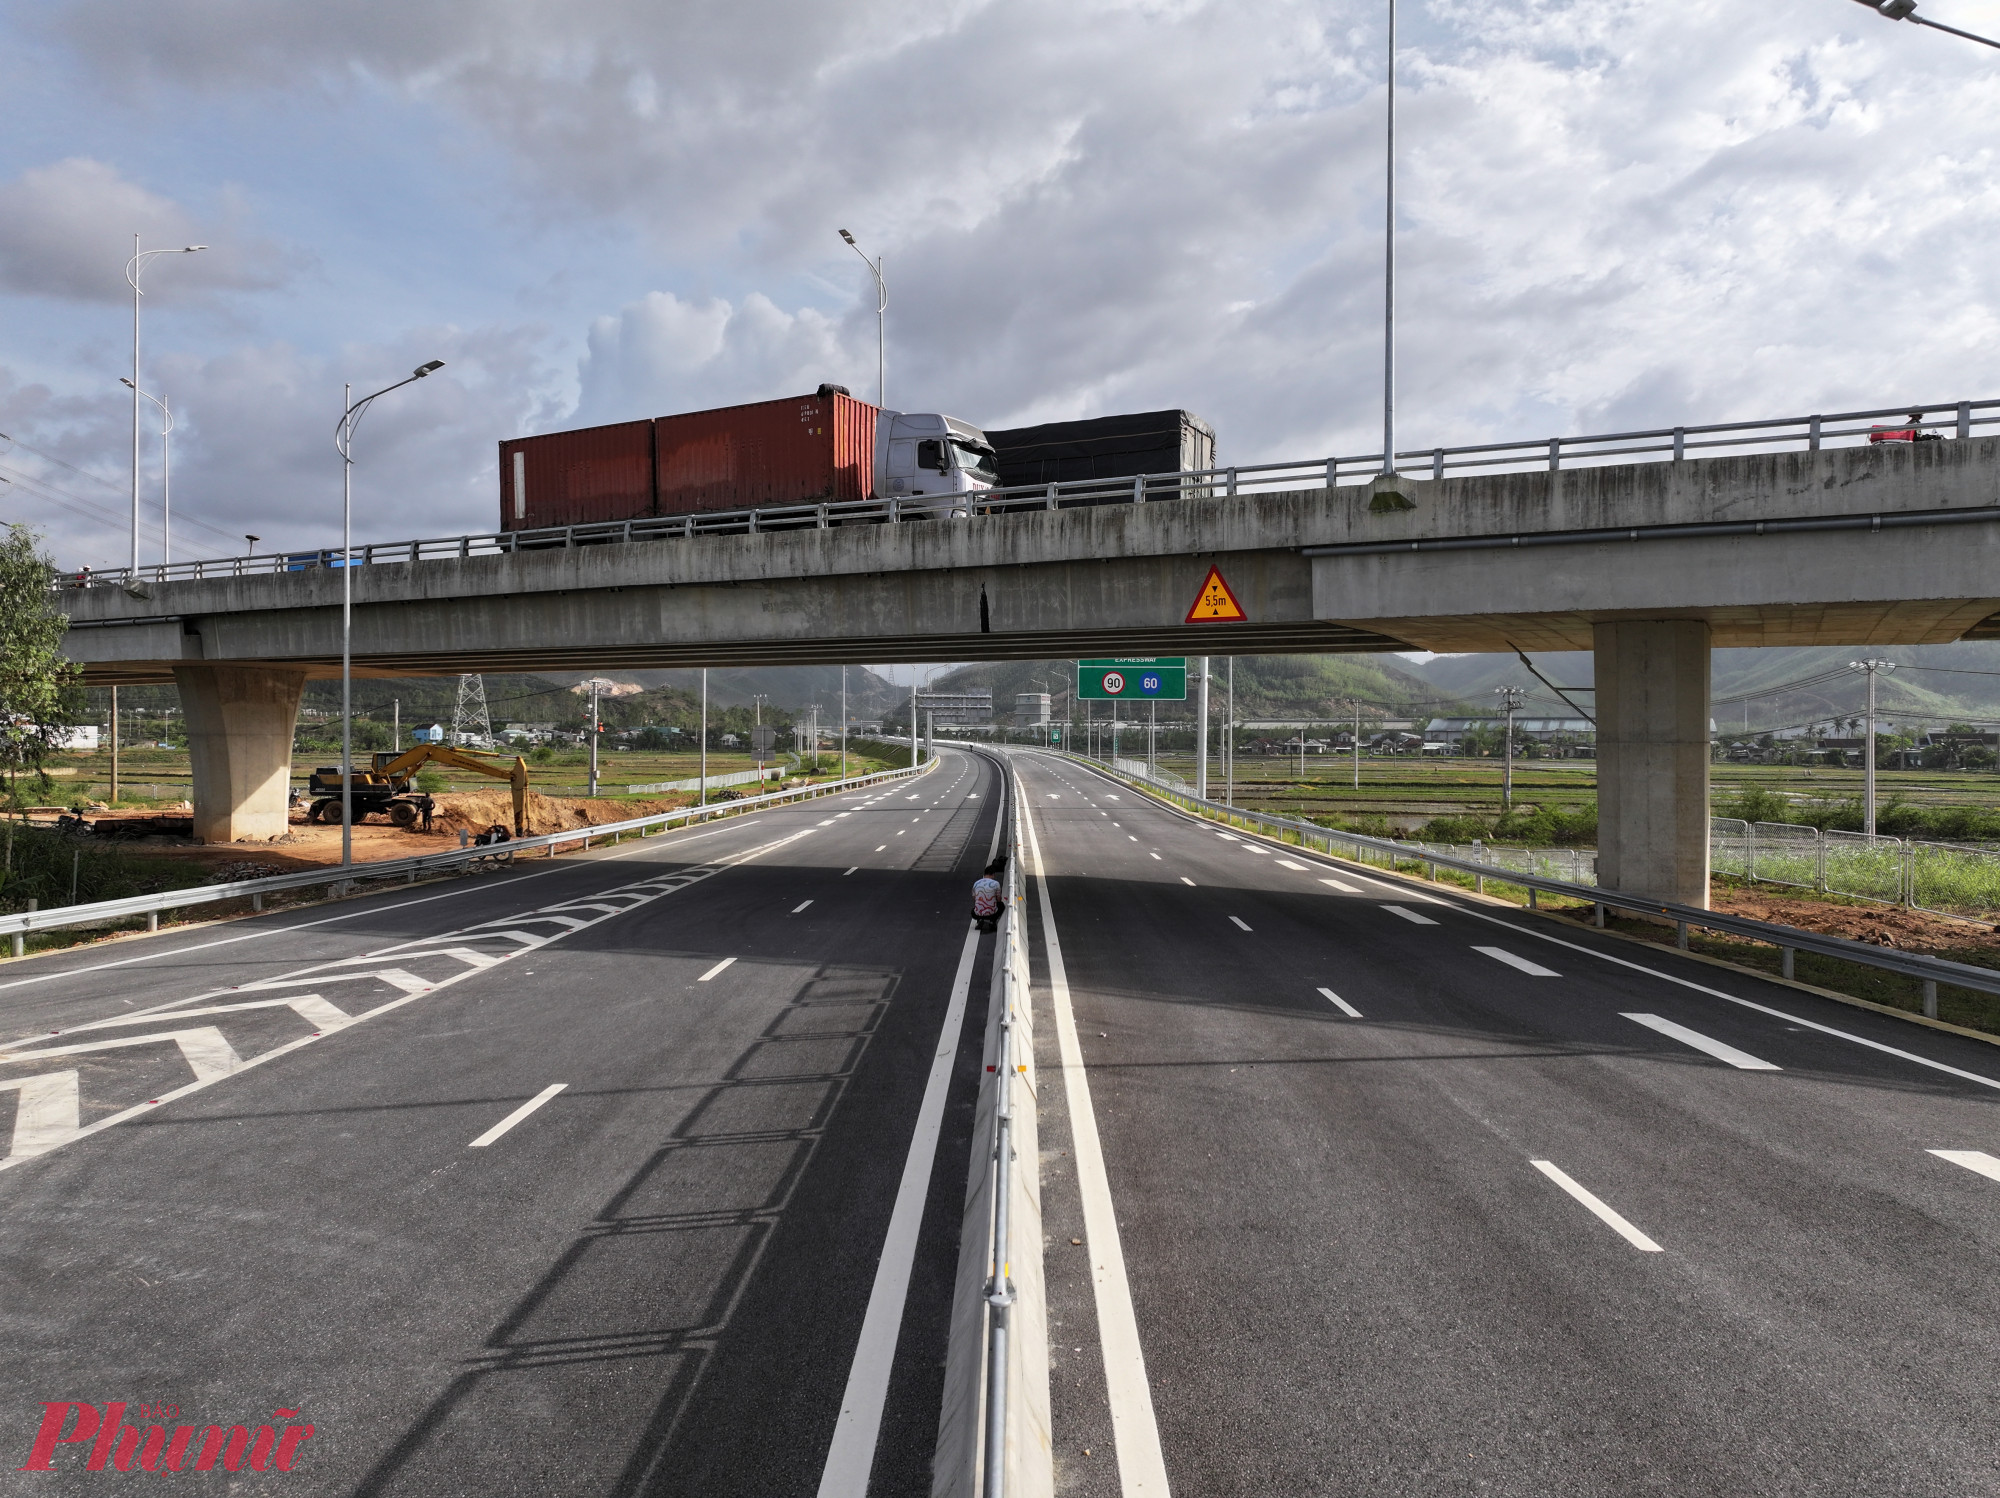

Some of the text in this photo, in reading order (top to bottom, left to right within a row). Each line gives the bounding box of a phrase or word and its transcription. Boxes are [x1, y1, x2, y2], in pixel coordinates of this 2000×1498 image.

[1205, 595, 1227, 607] 5,5m
[1107, 677, 1121, 689] 90
[1143, 677, 1158, 689] 60
